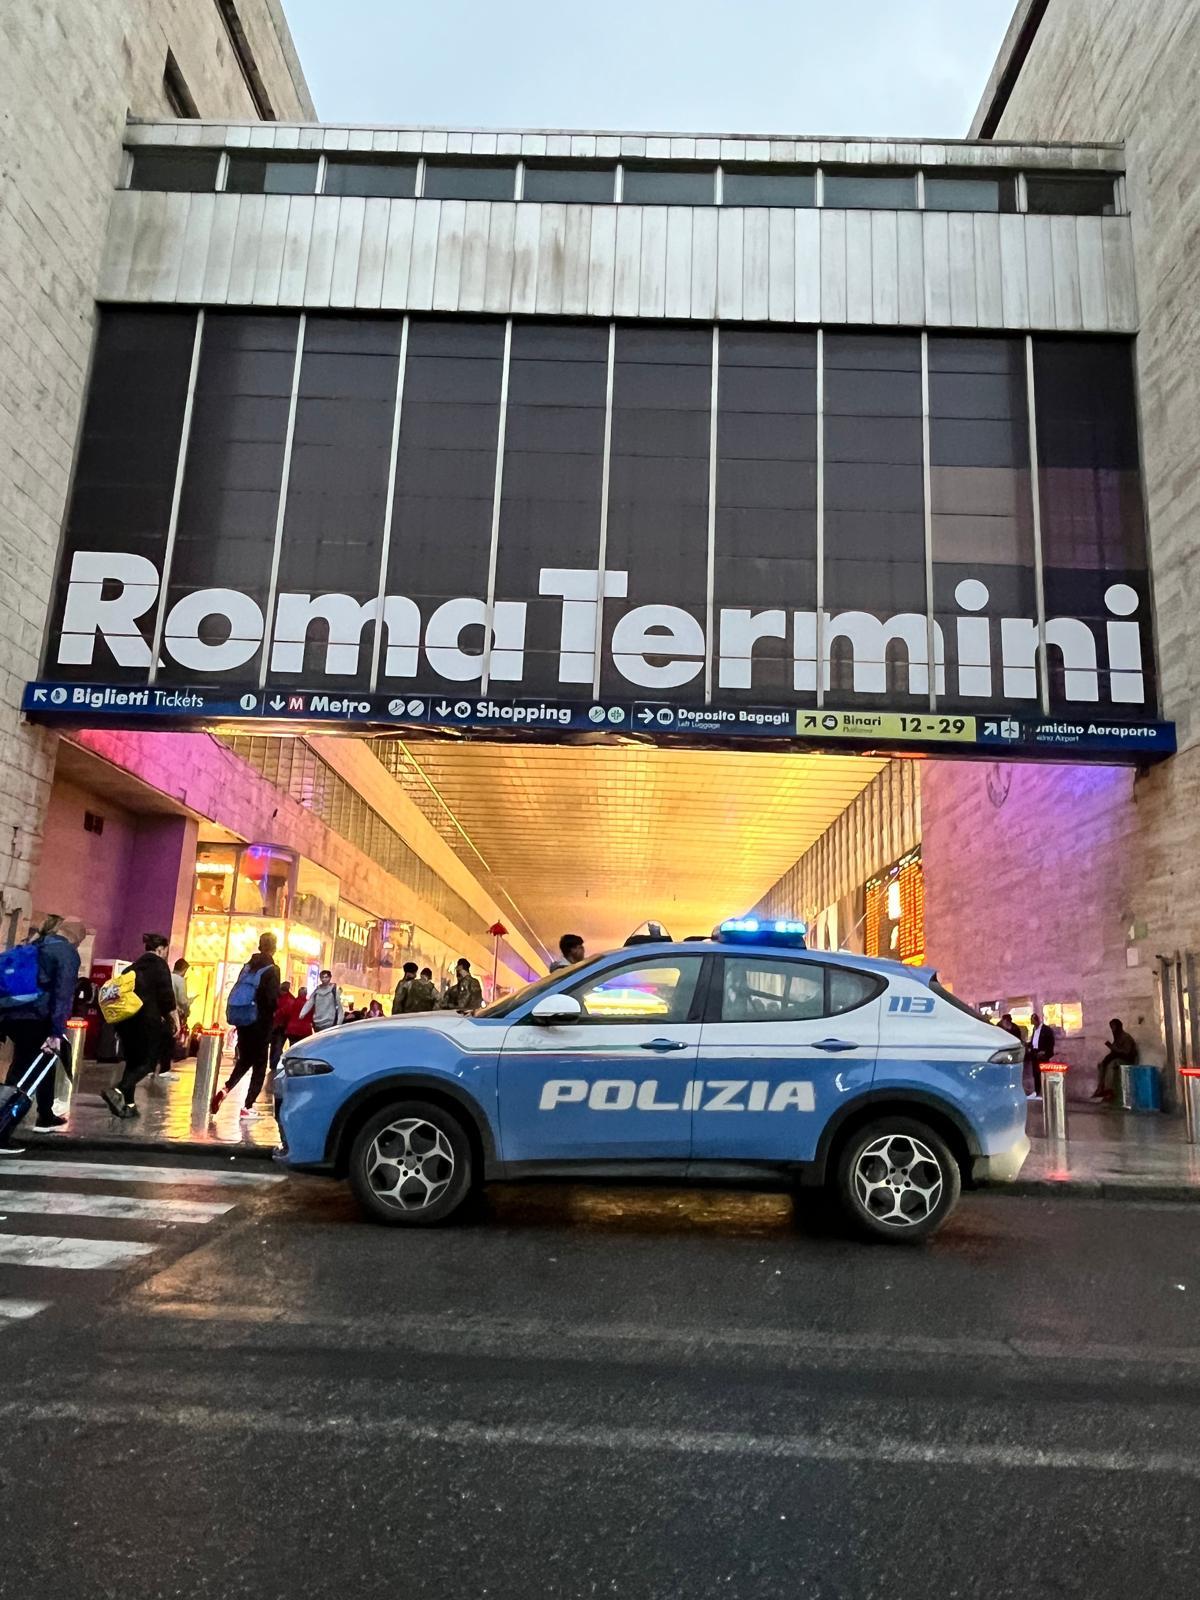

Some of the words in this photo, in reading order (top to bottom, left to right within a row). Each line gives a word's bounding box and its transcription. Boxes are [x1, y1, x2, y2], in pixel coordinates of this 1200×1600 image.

[57, 551, 527, 682] Roma
[539, 568, 1145, 704] Termini
[72, 688, 149, 709] Biglietti
[154, 691, 204, 708] Tickets
[310, 696, 371, 713] Metro
[476, 701, 572, 724] Shopping
[678, 709, 736, 722] Deposito
[739, 710, 790, 725] Bagagli
[843, 715, 882, 726] Binari
[1036, 723, 1085, 734] micino
[888, 996, 936, 1013] 113
[539, 1079, 816, 1112] POLIZIA
